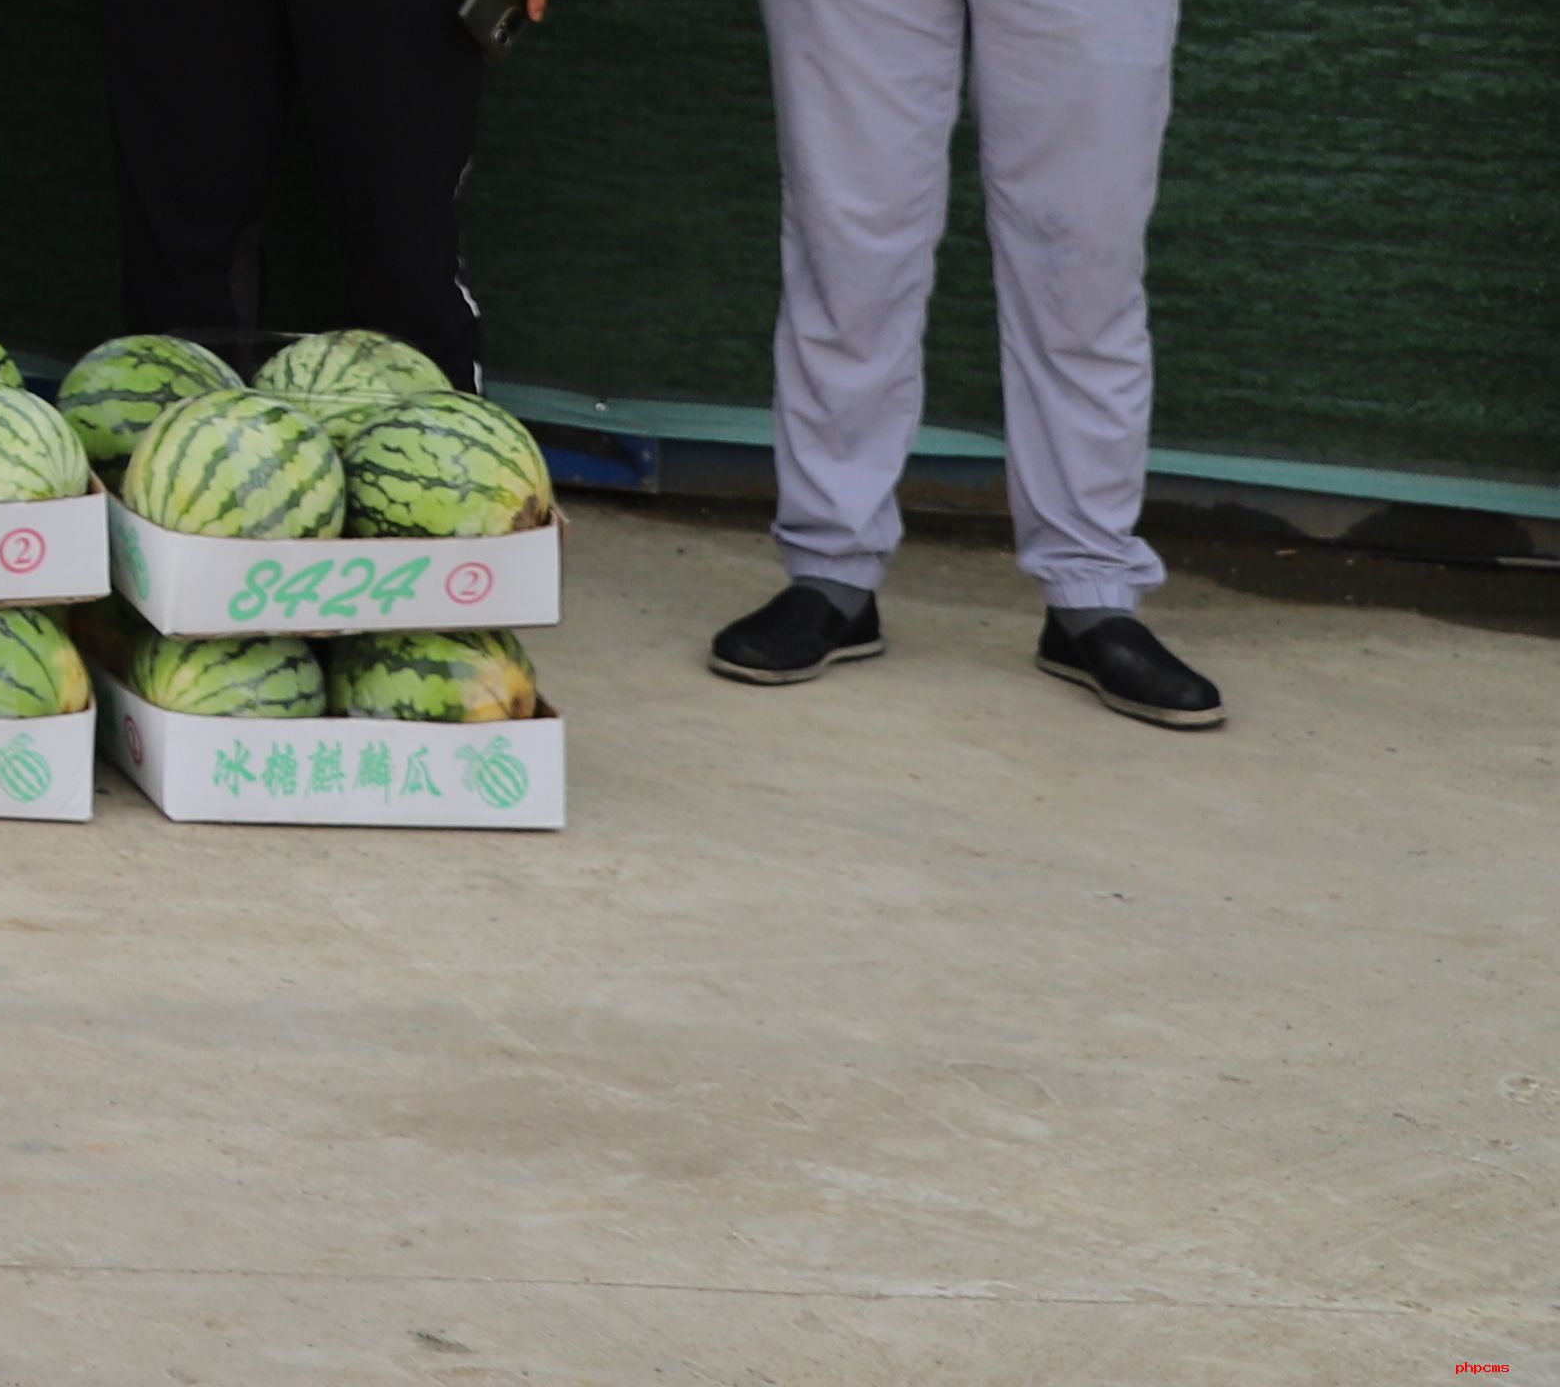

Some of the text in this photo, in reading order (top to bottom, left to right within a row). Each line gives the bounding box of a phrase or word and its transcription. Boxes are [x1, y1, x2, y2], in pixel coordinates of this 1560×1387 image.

[228, 555, 432, 622] 8424
[211, 738, 444, 805] 冰糖麒麟瓜
